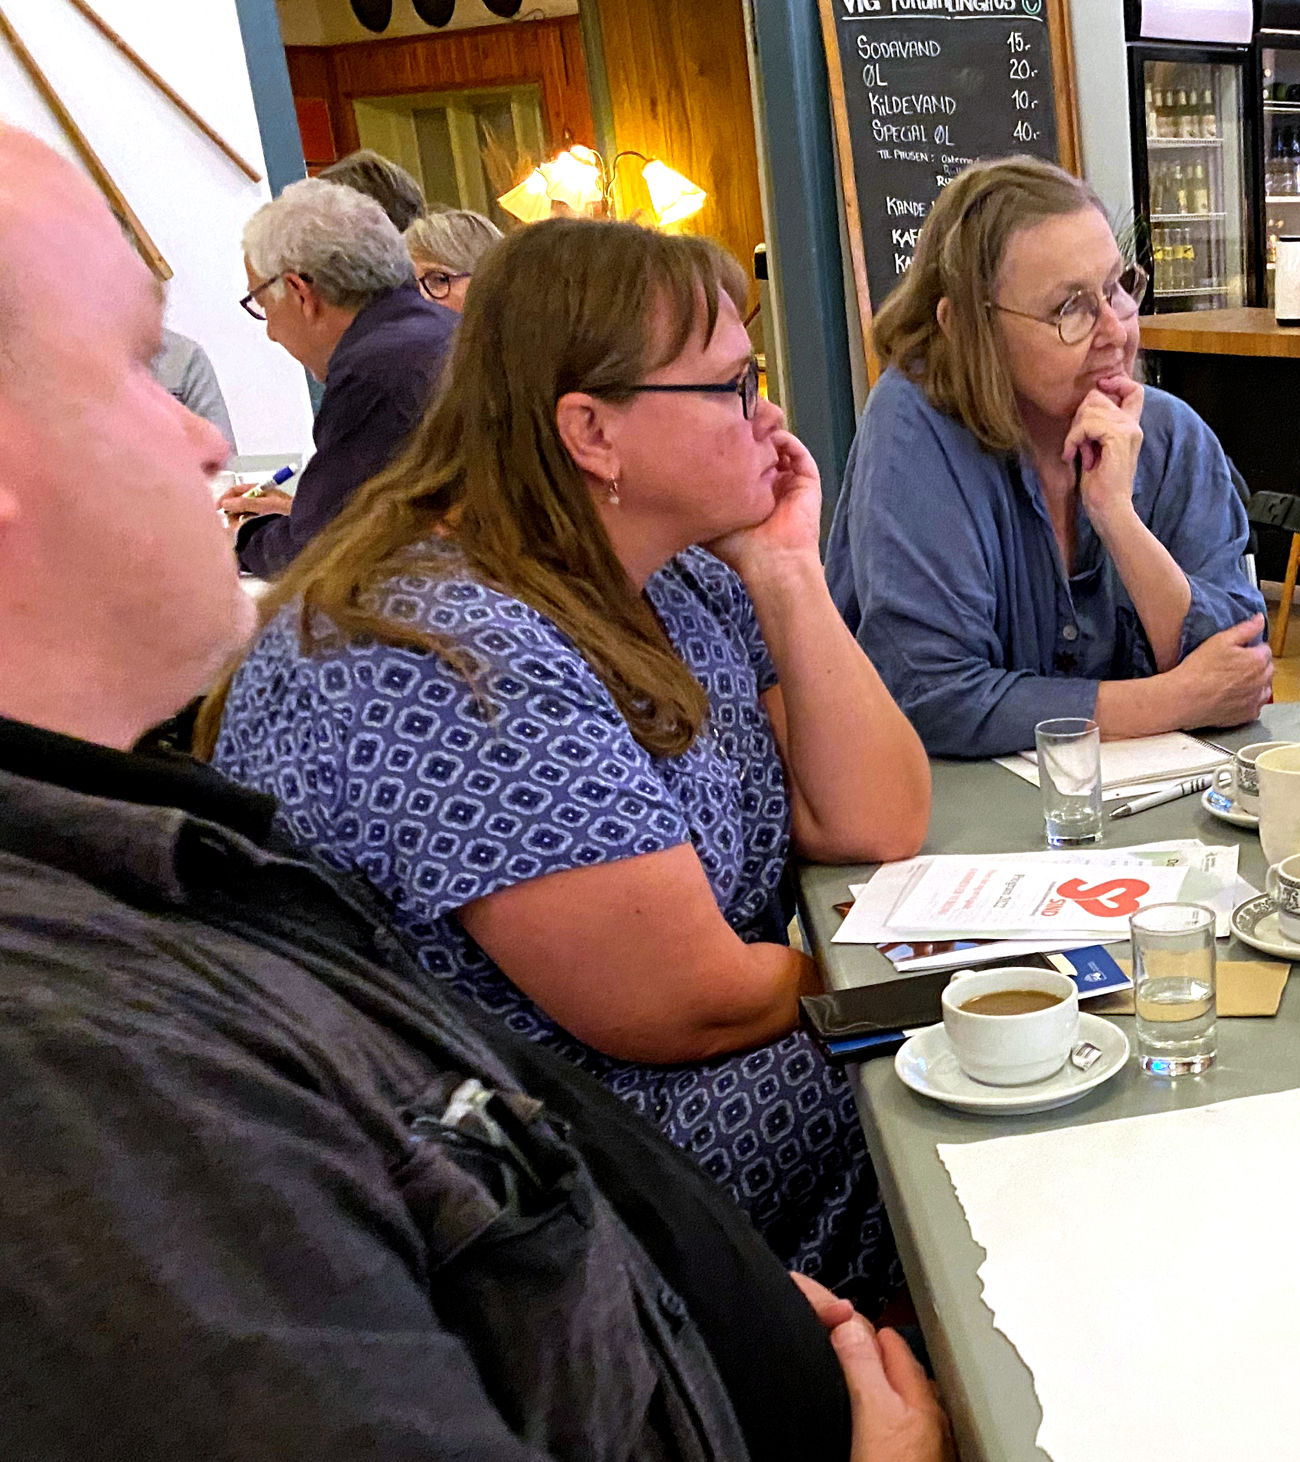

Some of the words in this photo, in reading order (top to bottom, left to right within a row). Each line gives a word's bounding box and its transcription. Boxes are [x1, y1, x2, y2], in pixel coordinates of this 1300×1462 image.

[857, 35, 941, 60] SODAVAND
[863, 64, 888, 87] ØL
[934, 124, 956, 146] ØL
[886, 196, 926, 217] KANDE
[1040, 898, 1066, 916] SIND
